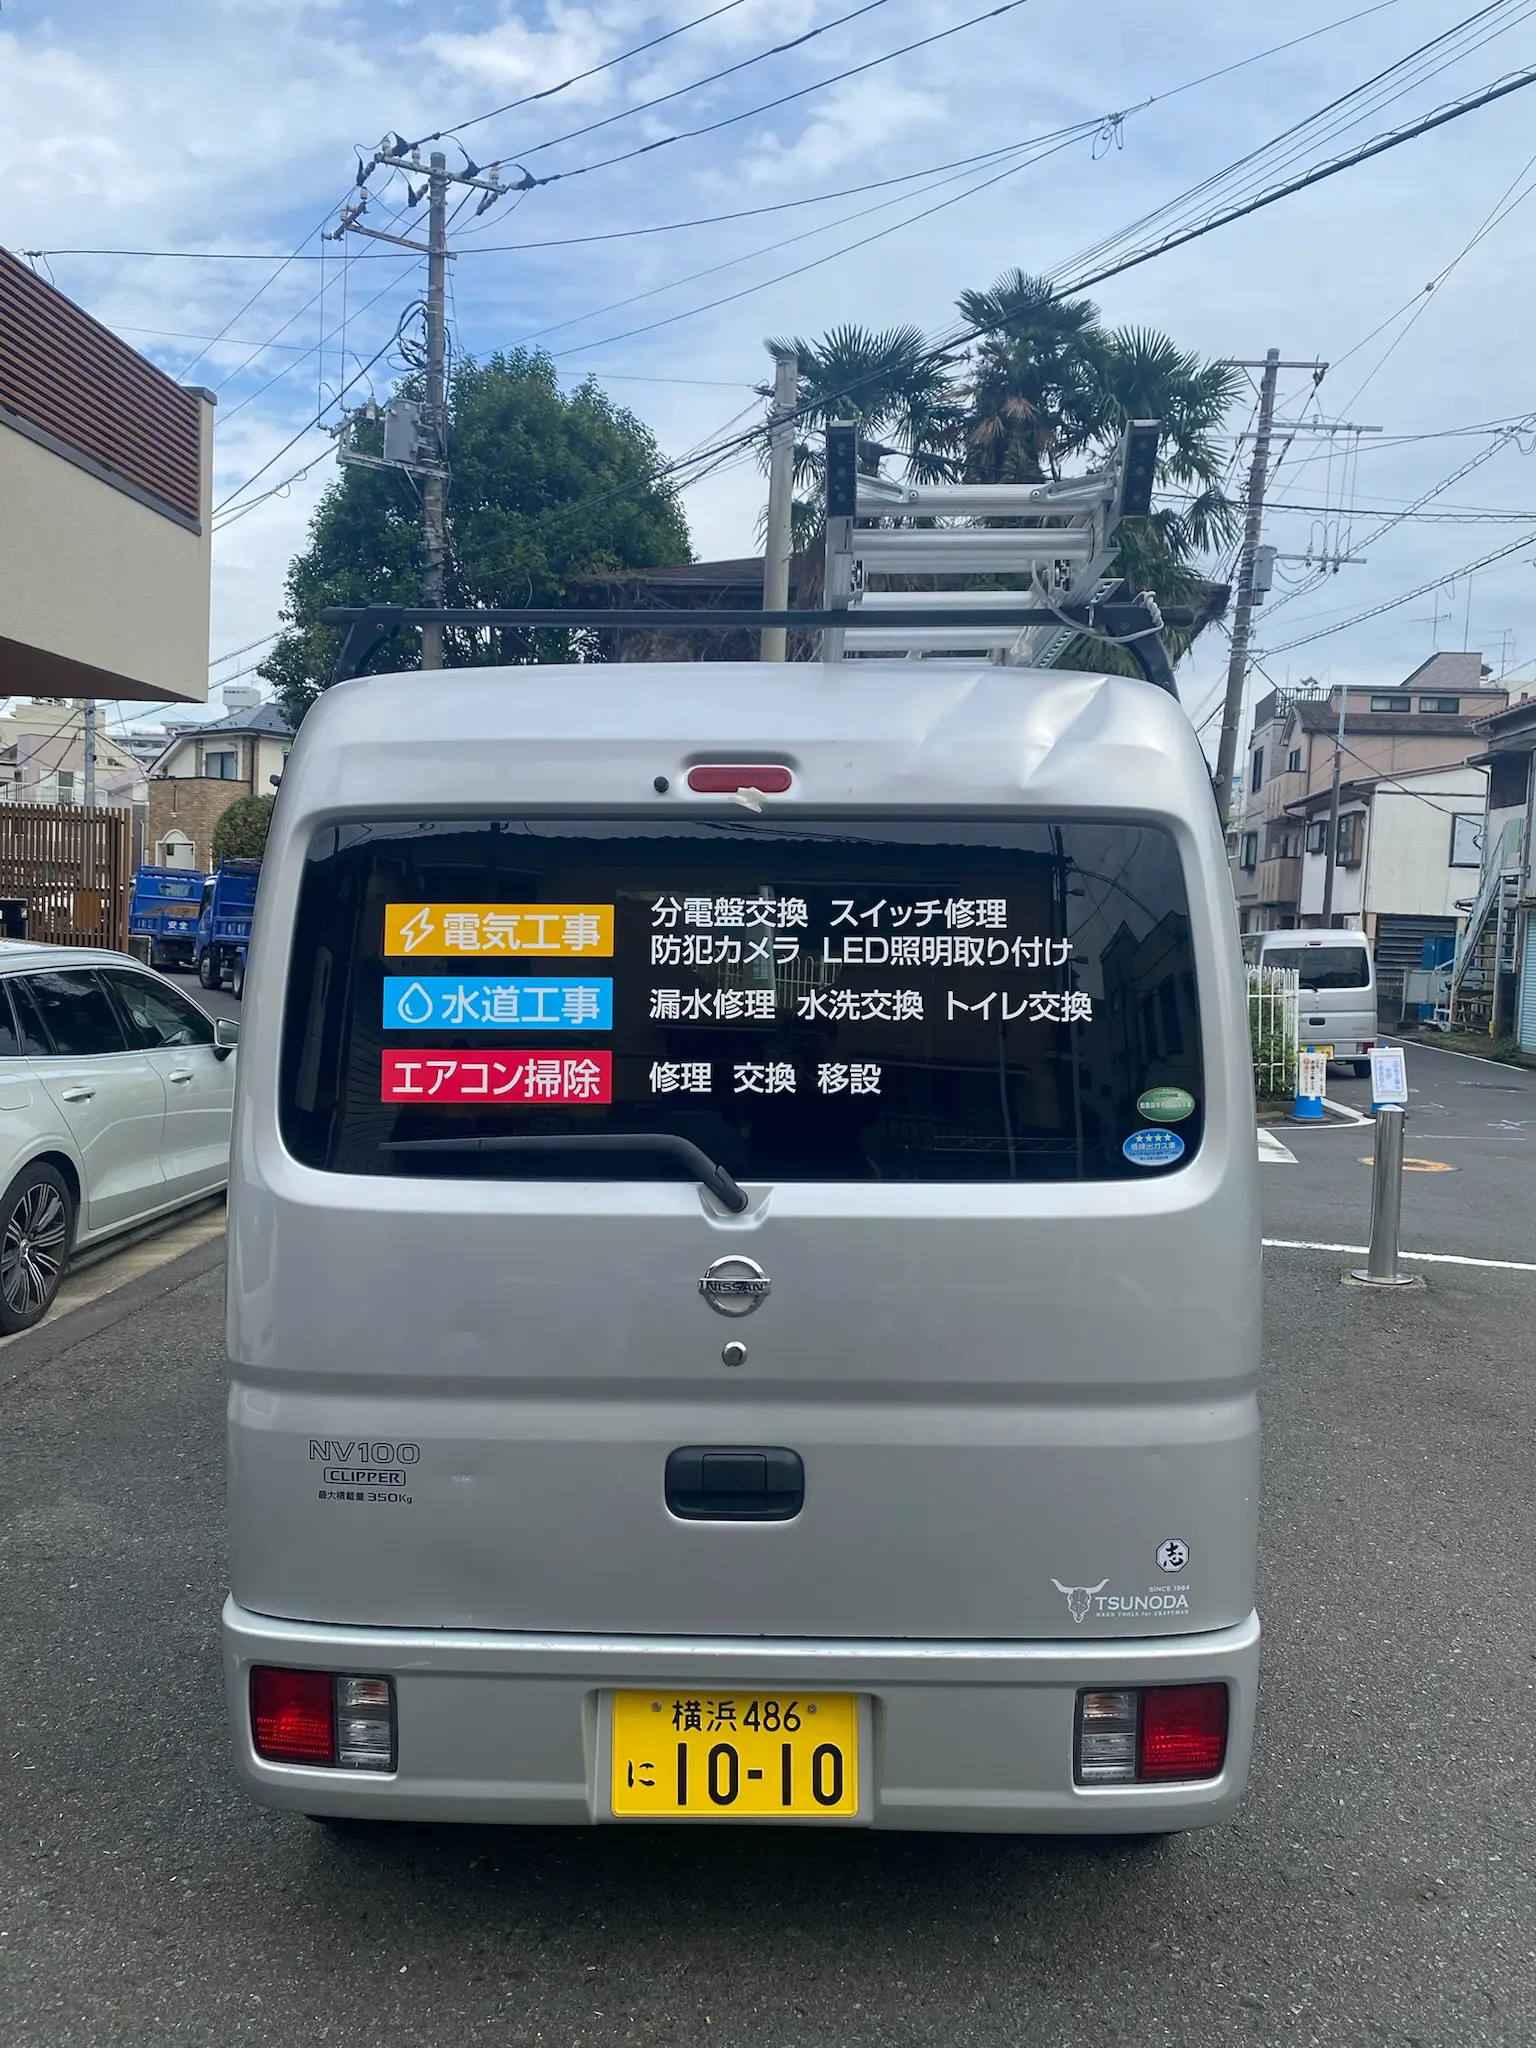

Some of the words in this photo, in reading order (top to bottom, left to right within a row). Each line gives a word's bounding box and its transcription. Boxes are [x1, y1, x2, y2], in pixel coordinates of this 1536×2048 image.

[168, 920, 188, 930] 安全
[650, 896, 808, 928] 分電盤交換
[830, 898, 1007, 929] スイッチ修理
[444, 912, 601, 951] 電気工事
[650, 934, 800, 965] 防犯カメラ
[823, 935, 1074, 967] LED照明取り付け
[441, 985, 601, 1024] 水道工事
[649, 988, 776, 1020] 漏水修理
[797, 988, 924, 1021] 水洗交換
[947, 990, 1093, 1022] トイレ交換
[392, 1058, 601, 1098] エアコン掃除
[649, 1061, 712, 1093] 修理
[733, 1061, 797, 1094] 交換
[817, 1062, 881, 1094] 移設
[706, 1282, 763, 1293] NISSAN
[309, 1439, 421, 1465] NV100
[329, 1470, 401, 1484] CLIPPER
[318, 1489, 364, 1502] 最大積載量
[367, 1492, 413, 1505] 350Kg
[1163, 1542, 1184, 1567] 志
[1094, 1594, 1189, 1611] TSUNODA
[627, 1760, 656, 1788] に
[677, 1742, 844, 1807] 10-10
